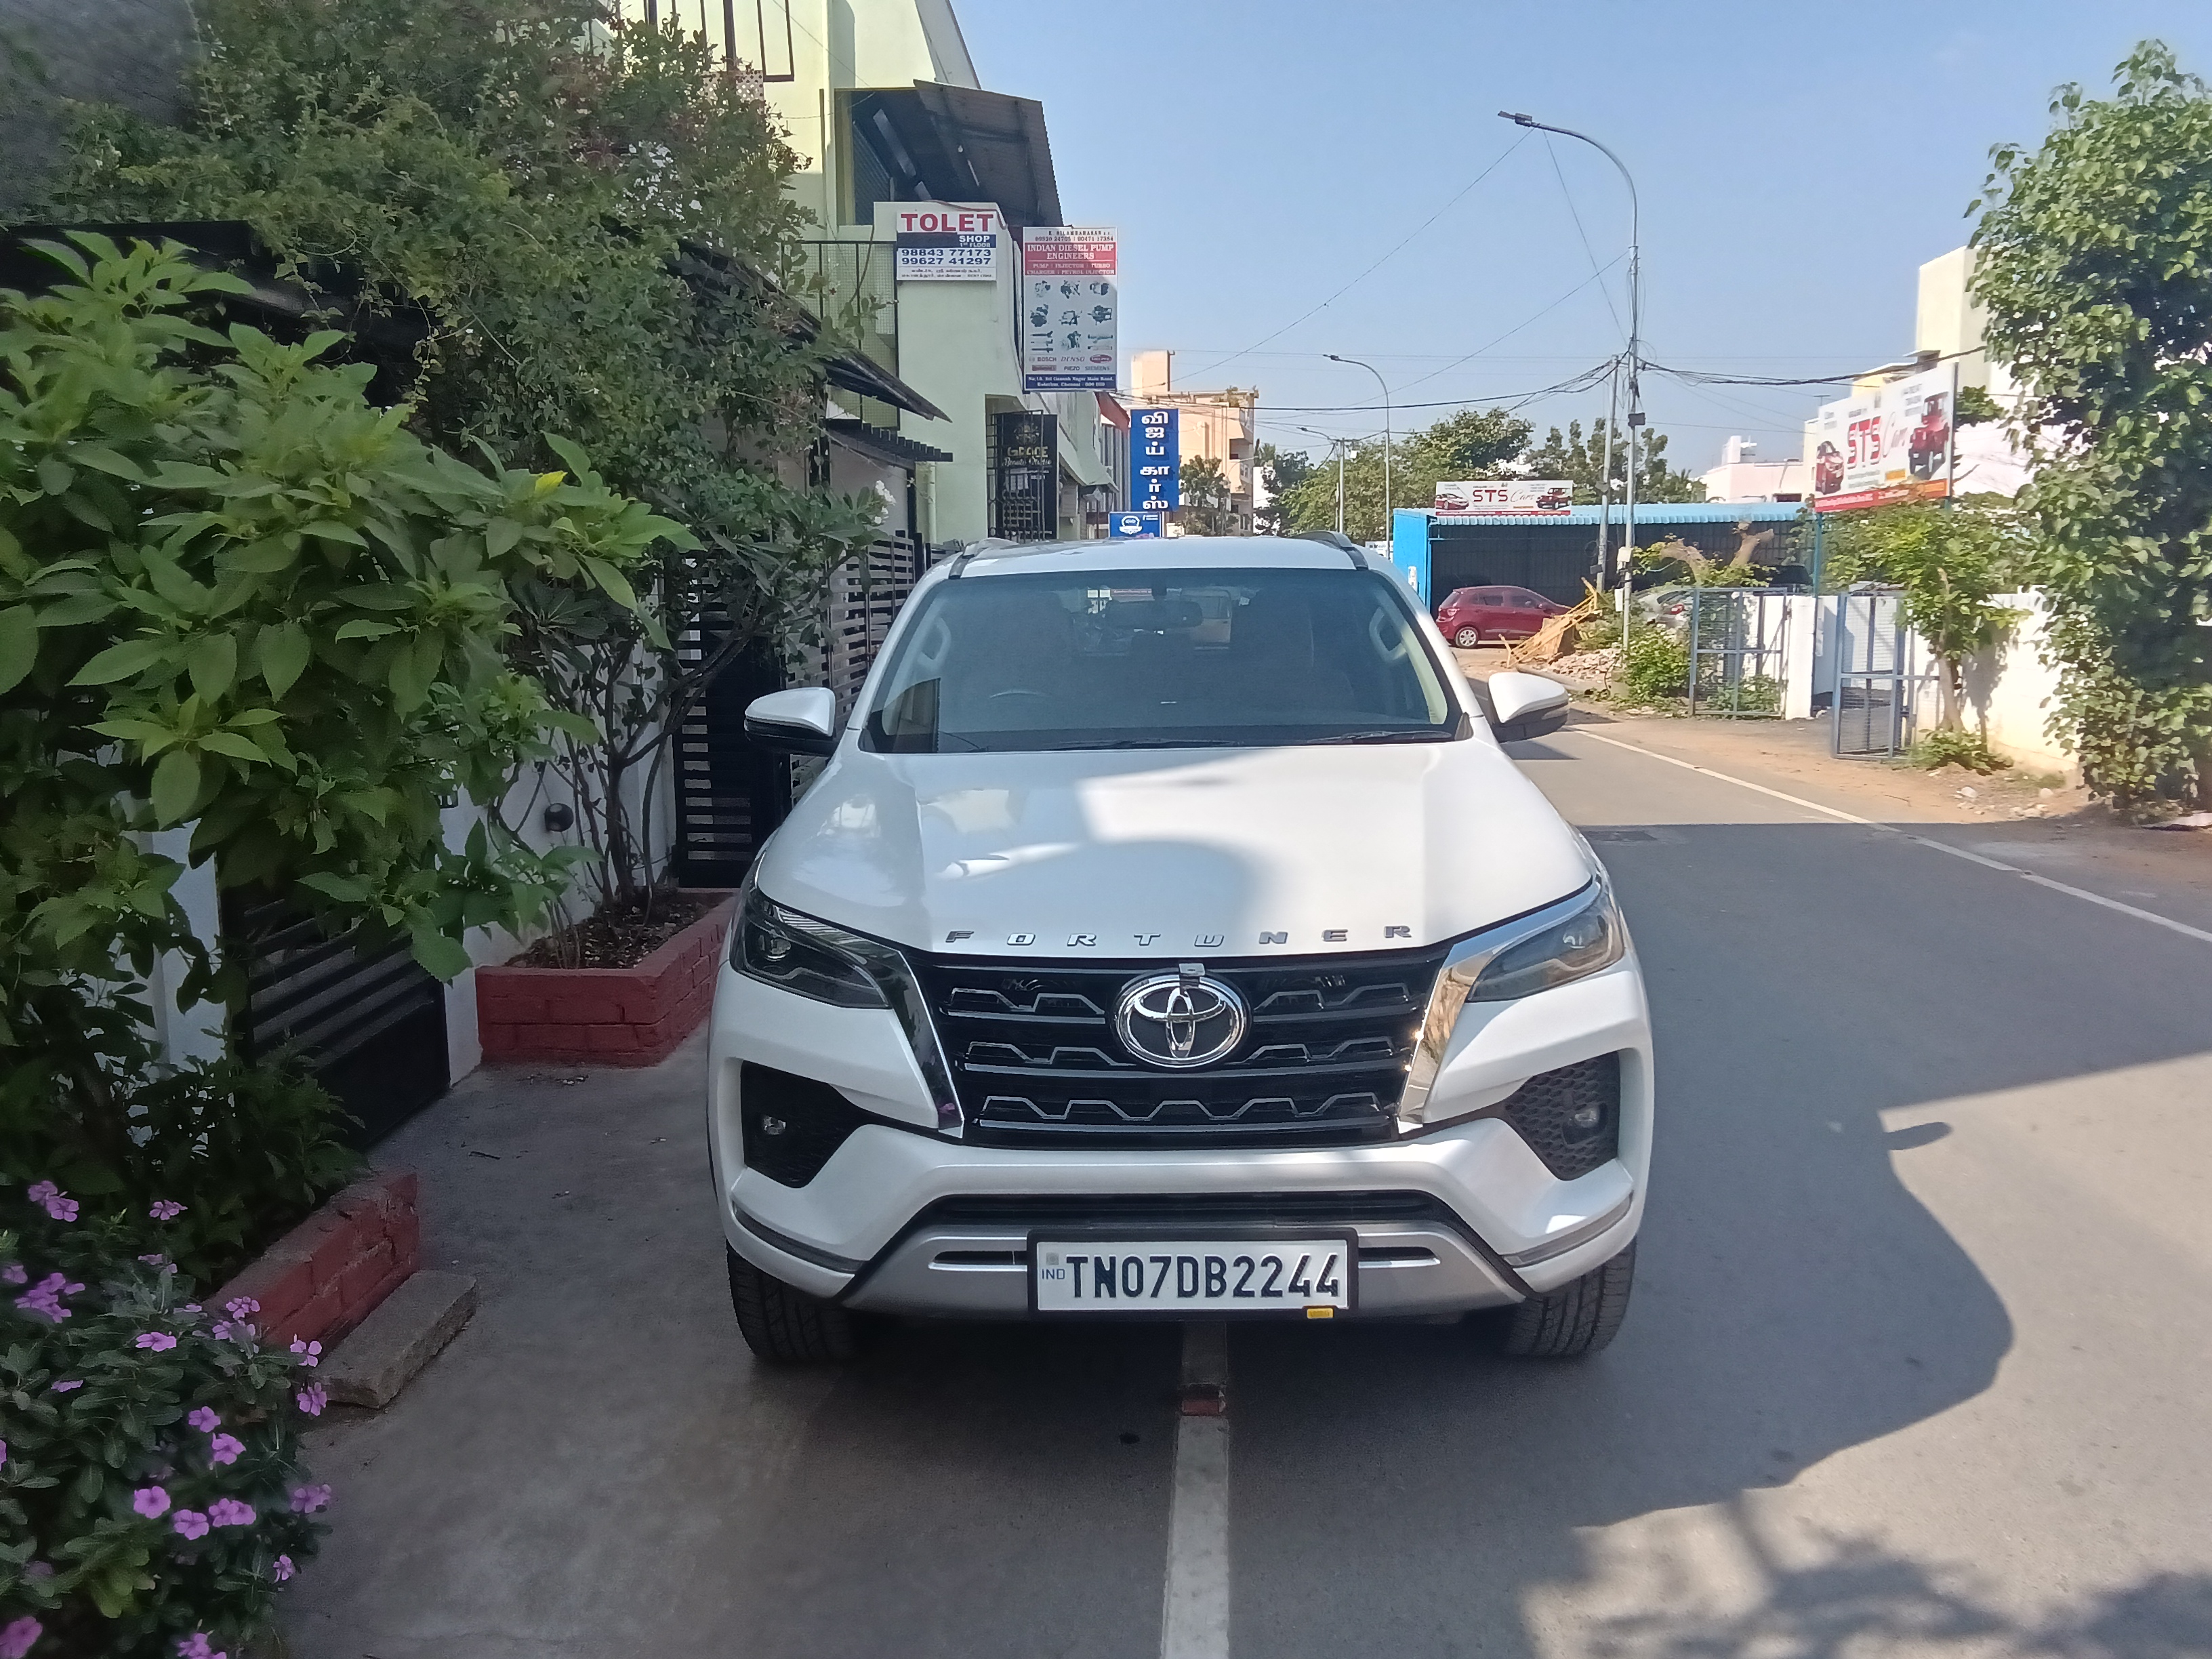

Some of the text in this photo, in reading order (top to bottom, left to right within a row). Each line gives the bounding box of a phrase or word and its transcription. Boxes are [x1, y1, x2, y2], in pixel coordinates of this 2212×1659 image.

[901, 213, 994, 232] TOLET
[1847, 415, 1881, 468] STS
[1473, 489, 1534, 503] STS Cars
[945, 925, 1413, 947] FORTUNER
[1041, 1254, 1339, 1298] IND TN07DB2244
